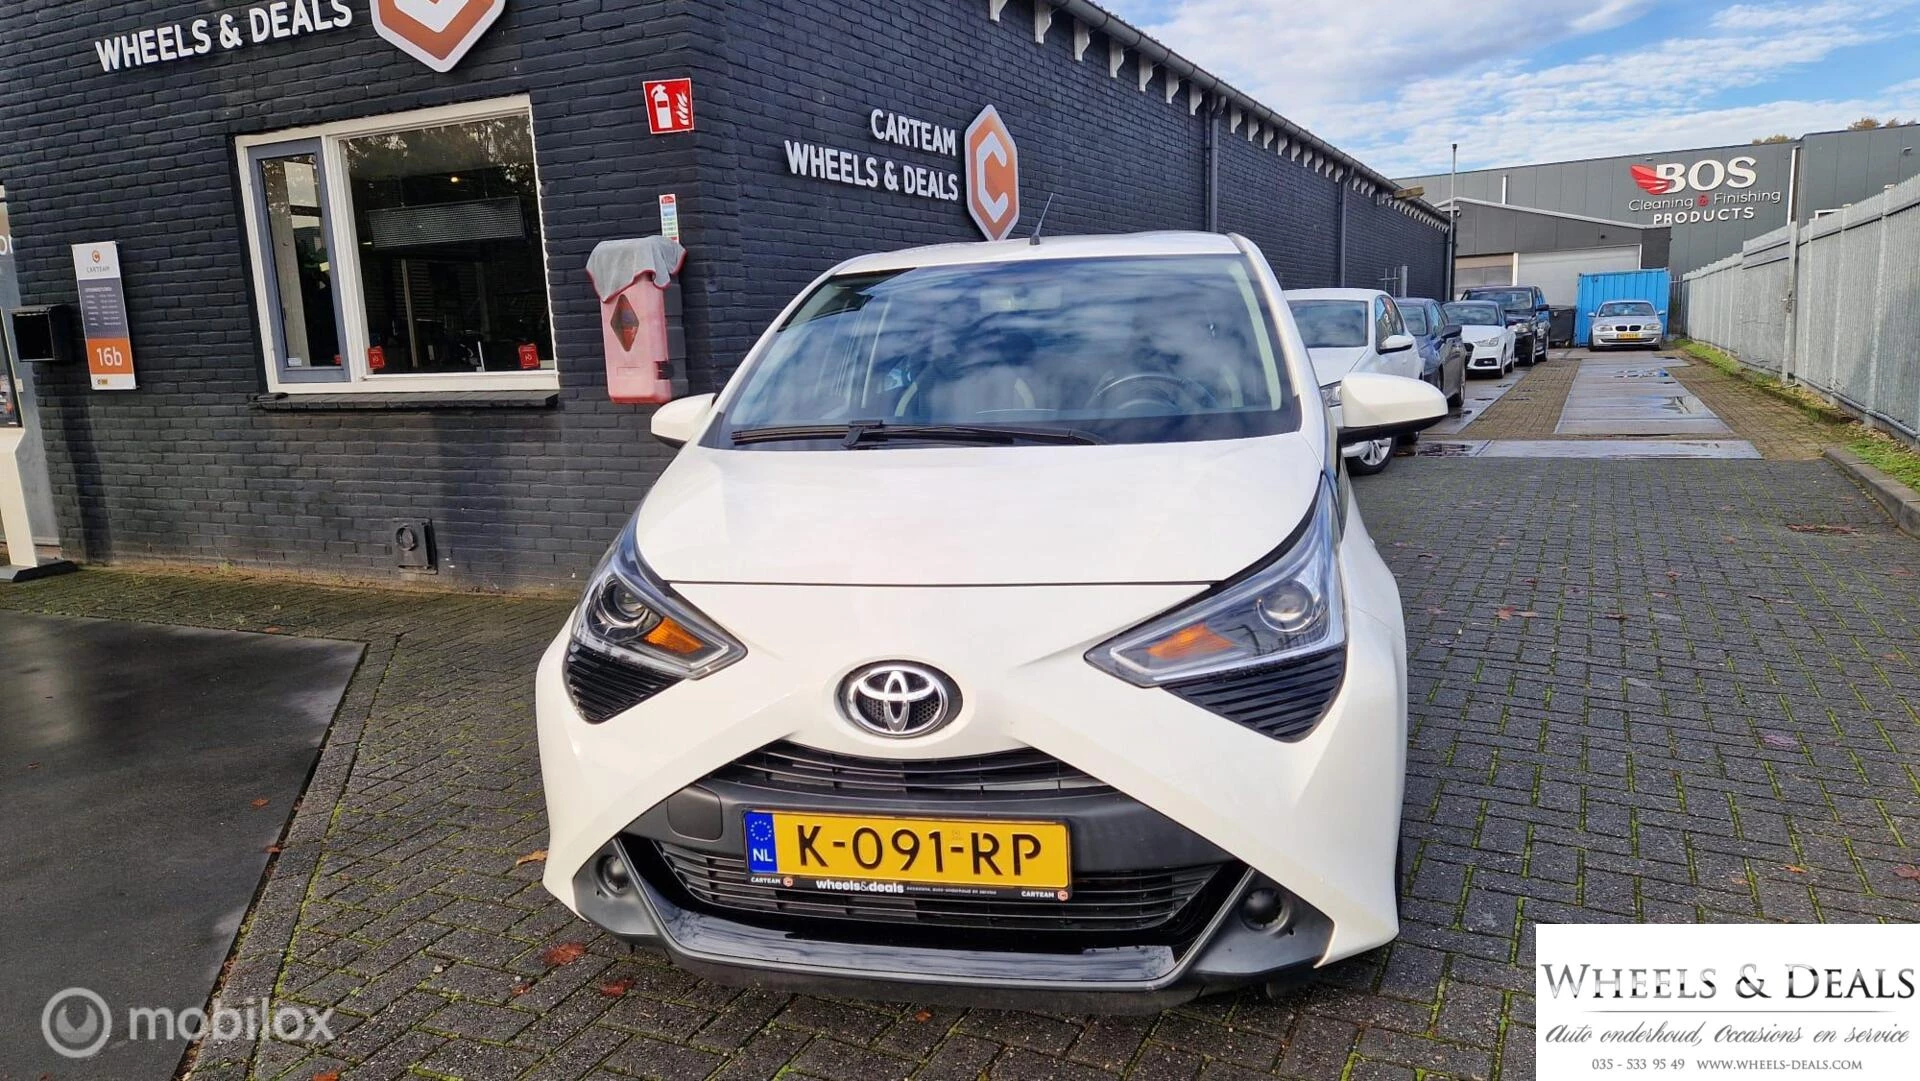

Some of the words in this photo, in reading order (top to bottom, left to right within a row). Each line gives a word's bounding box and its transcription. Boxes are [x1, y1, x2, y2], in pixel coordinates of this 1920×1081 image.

[95, 19, 212, 73] WHEELS
[218, 13, 243, 49] &
[250, 0, 353, 44] DEALS
[870, 108, 957, 157] CARTEAM
[784, 140, 878, 189] WHEELS
[883, 161, 899, 191] &
[903, 165, 959, 201] DEALS
[1656, 156, 1757, 194] BOS
[1628, 196, 1694, 212] Cleaning
[1714, 190, 1781, 205] Finishing
[1653, 207, 1755, 225] PRODUCTS
[96, 347, 123, 367] 16b
[753, 847, 774, 863] NL
[797, 824, 1042, 877] K-091-RP
[750, 876, 781, 884] CARTEAM
[815, 879, 905, 894] wheels&deals
[1021, 890, 1055, 898] CARTEAM
